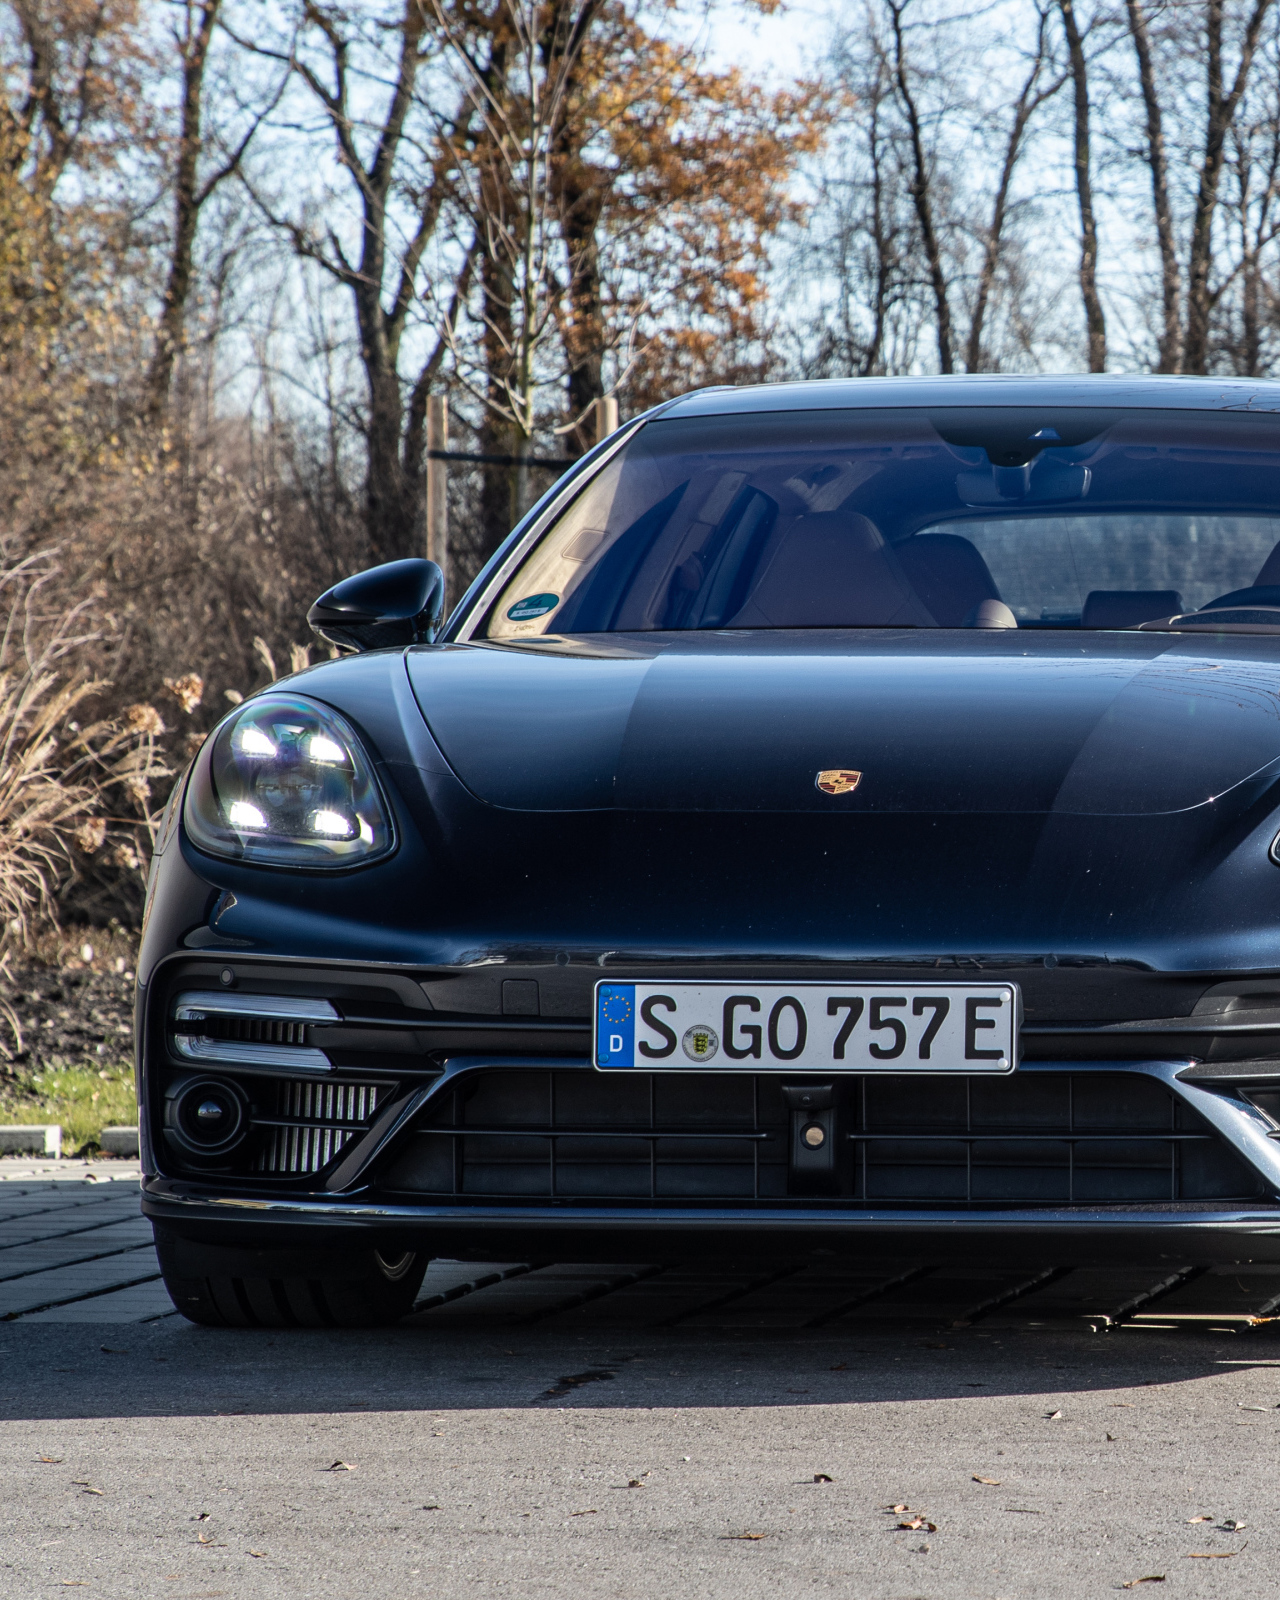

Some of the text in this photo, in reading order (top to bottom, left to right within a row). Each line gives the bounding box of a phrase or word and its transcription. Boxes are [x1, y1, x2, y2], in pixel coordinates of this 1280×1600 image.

[529, 594, 544, 607] 4
[638, 994, 678, 1059] S
[723, 995, 808, 1060] GO
[609, 1034, 623, 1052] D
